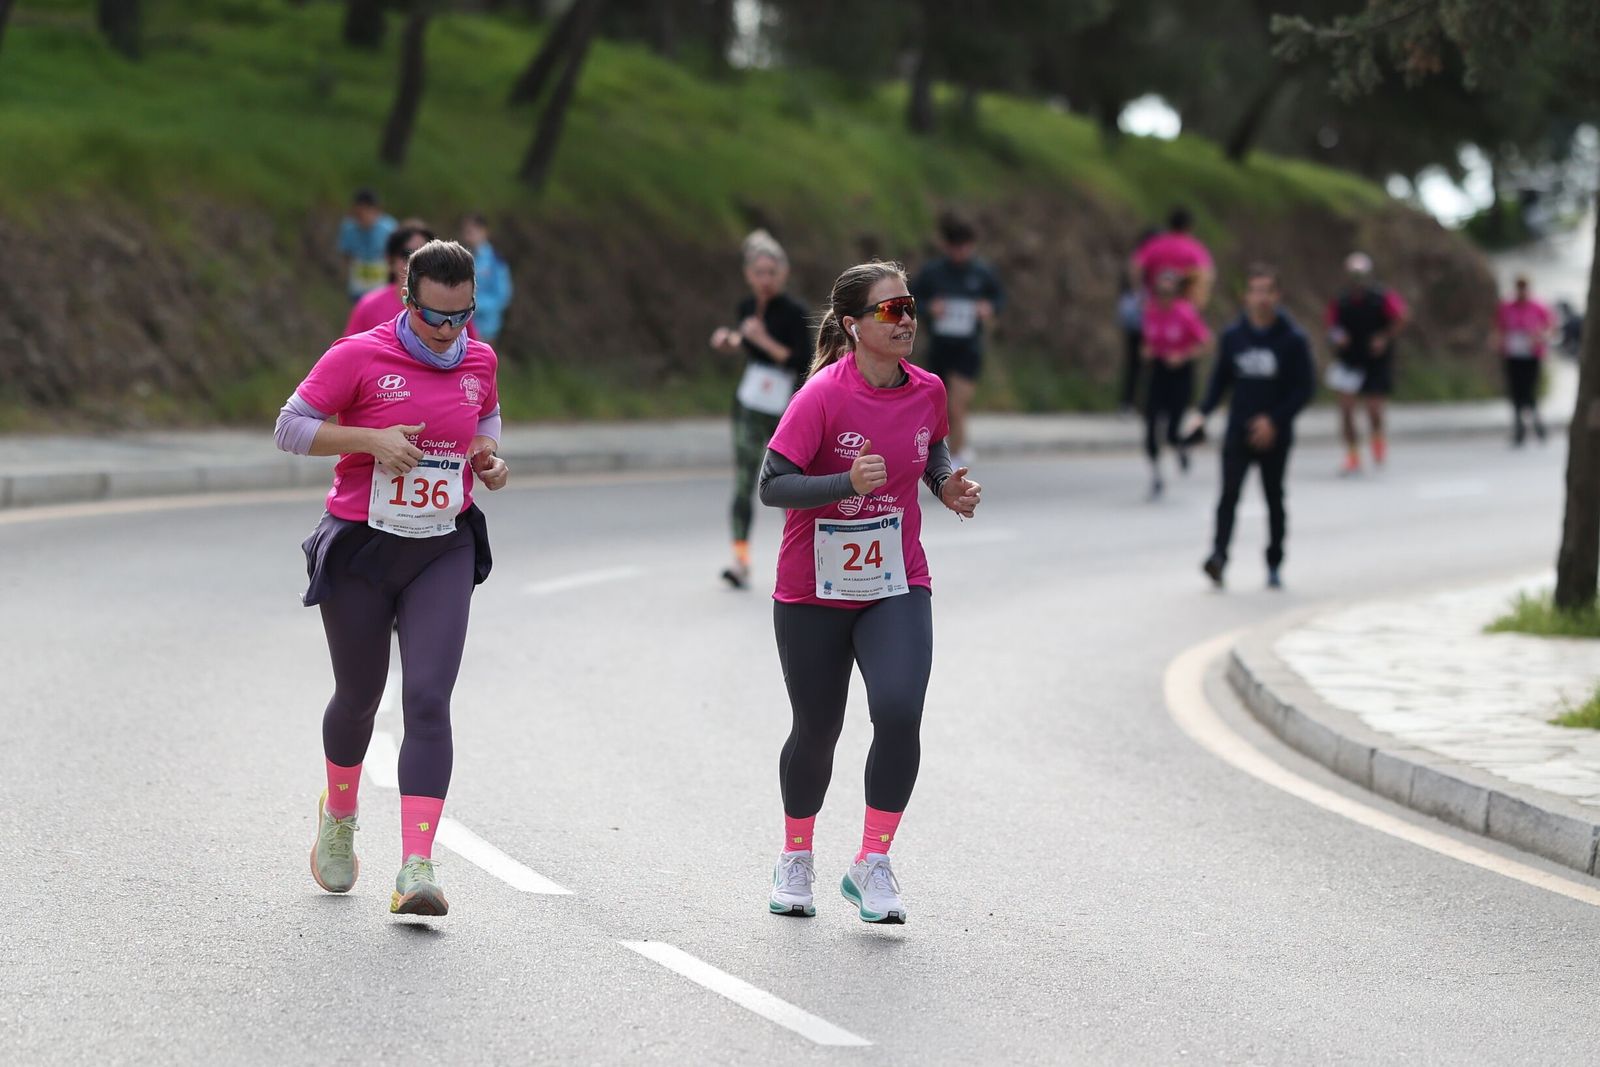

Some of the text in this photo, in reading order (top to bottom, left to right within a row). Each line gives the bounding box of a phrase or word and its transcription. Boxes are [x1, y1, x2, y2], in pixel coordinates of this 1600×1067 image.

[376, 390, 411, 399] HYUNDAI
[421, 439, 457, 449] Ciudad
[834, 447, 860, 457] HYUND
[388, 475, 450, 510] 136
[842, 540, 883, 571] 24
